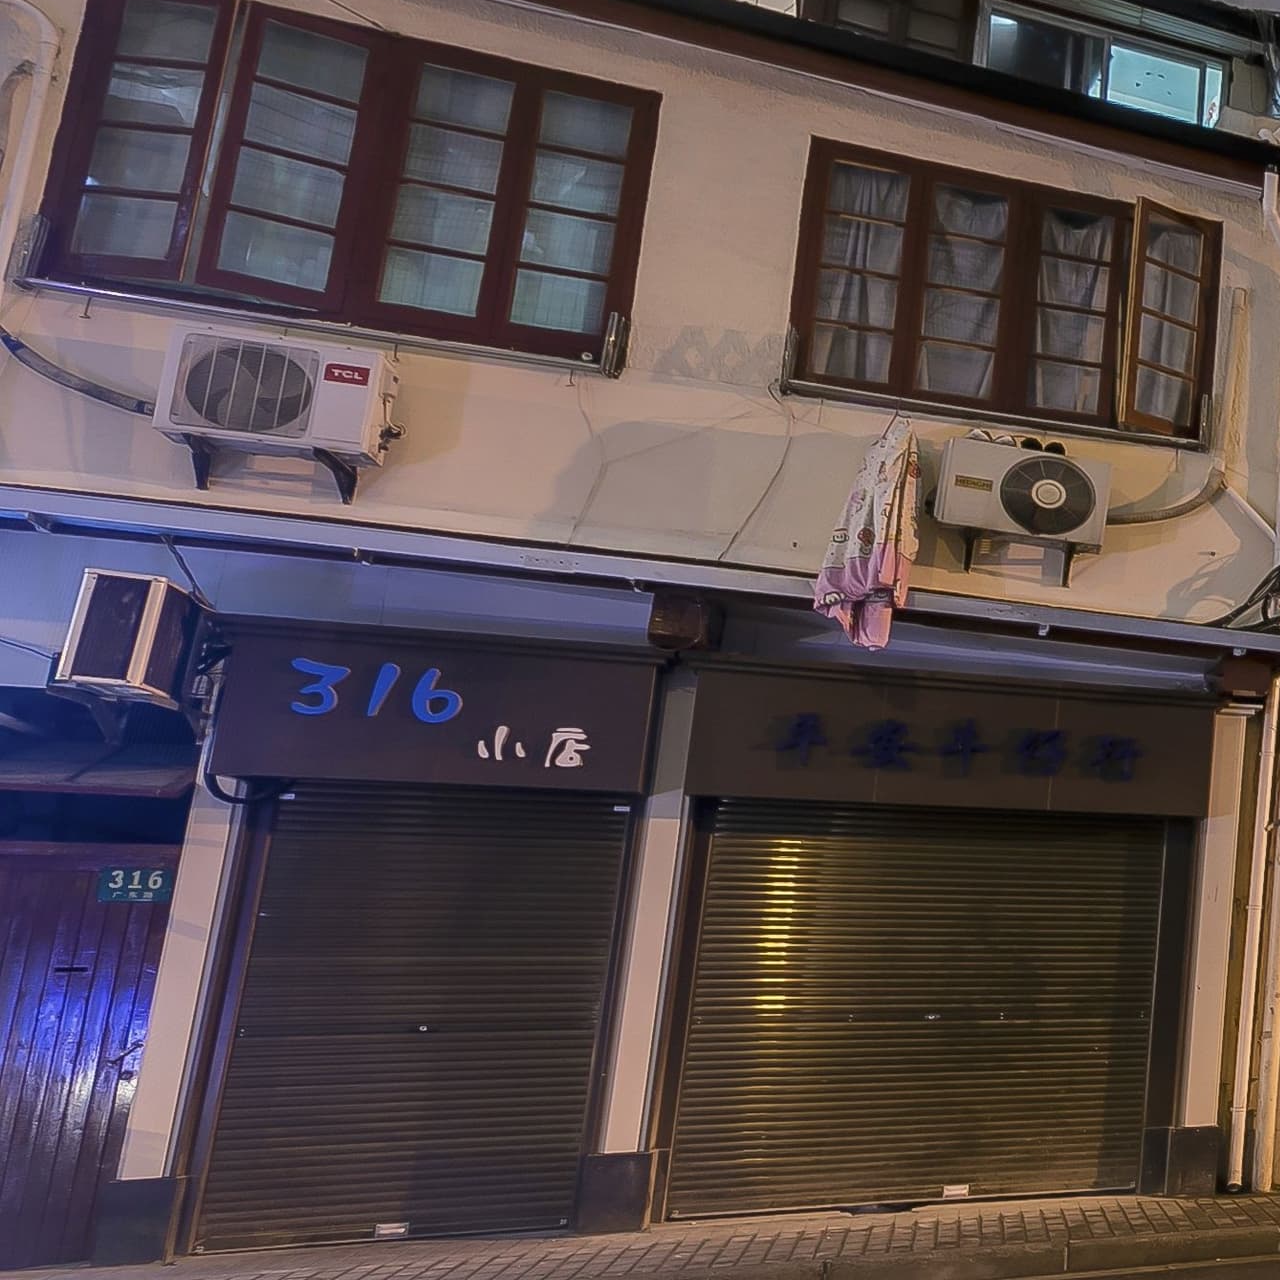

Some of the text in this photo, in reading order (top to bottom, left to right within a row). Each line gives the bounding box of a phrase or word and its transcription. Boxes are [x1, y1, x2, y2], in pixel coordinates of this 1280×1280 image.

[331, 368, 363, 380] TCL
[291, 657, 464, 723] 316
[477, 725, 591, 769] 小店
[108, 870, 164, 889] 316
